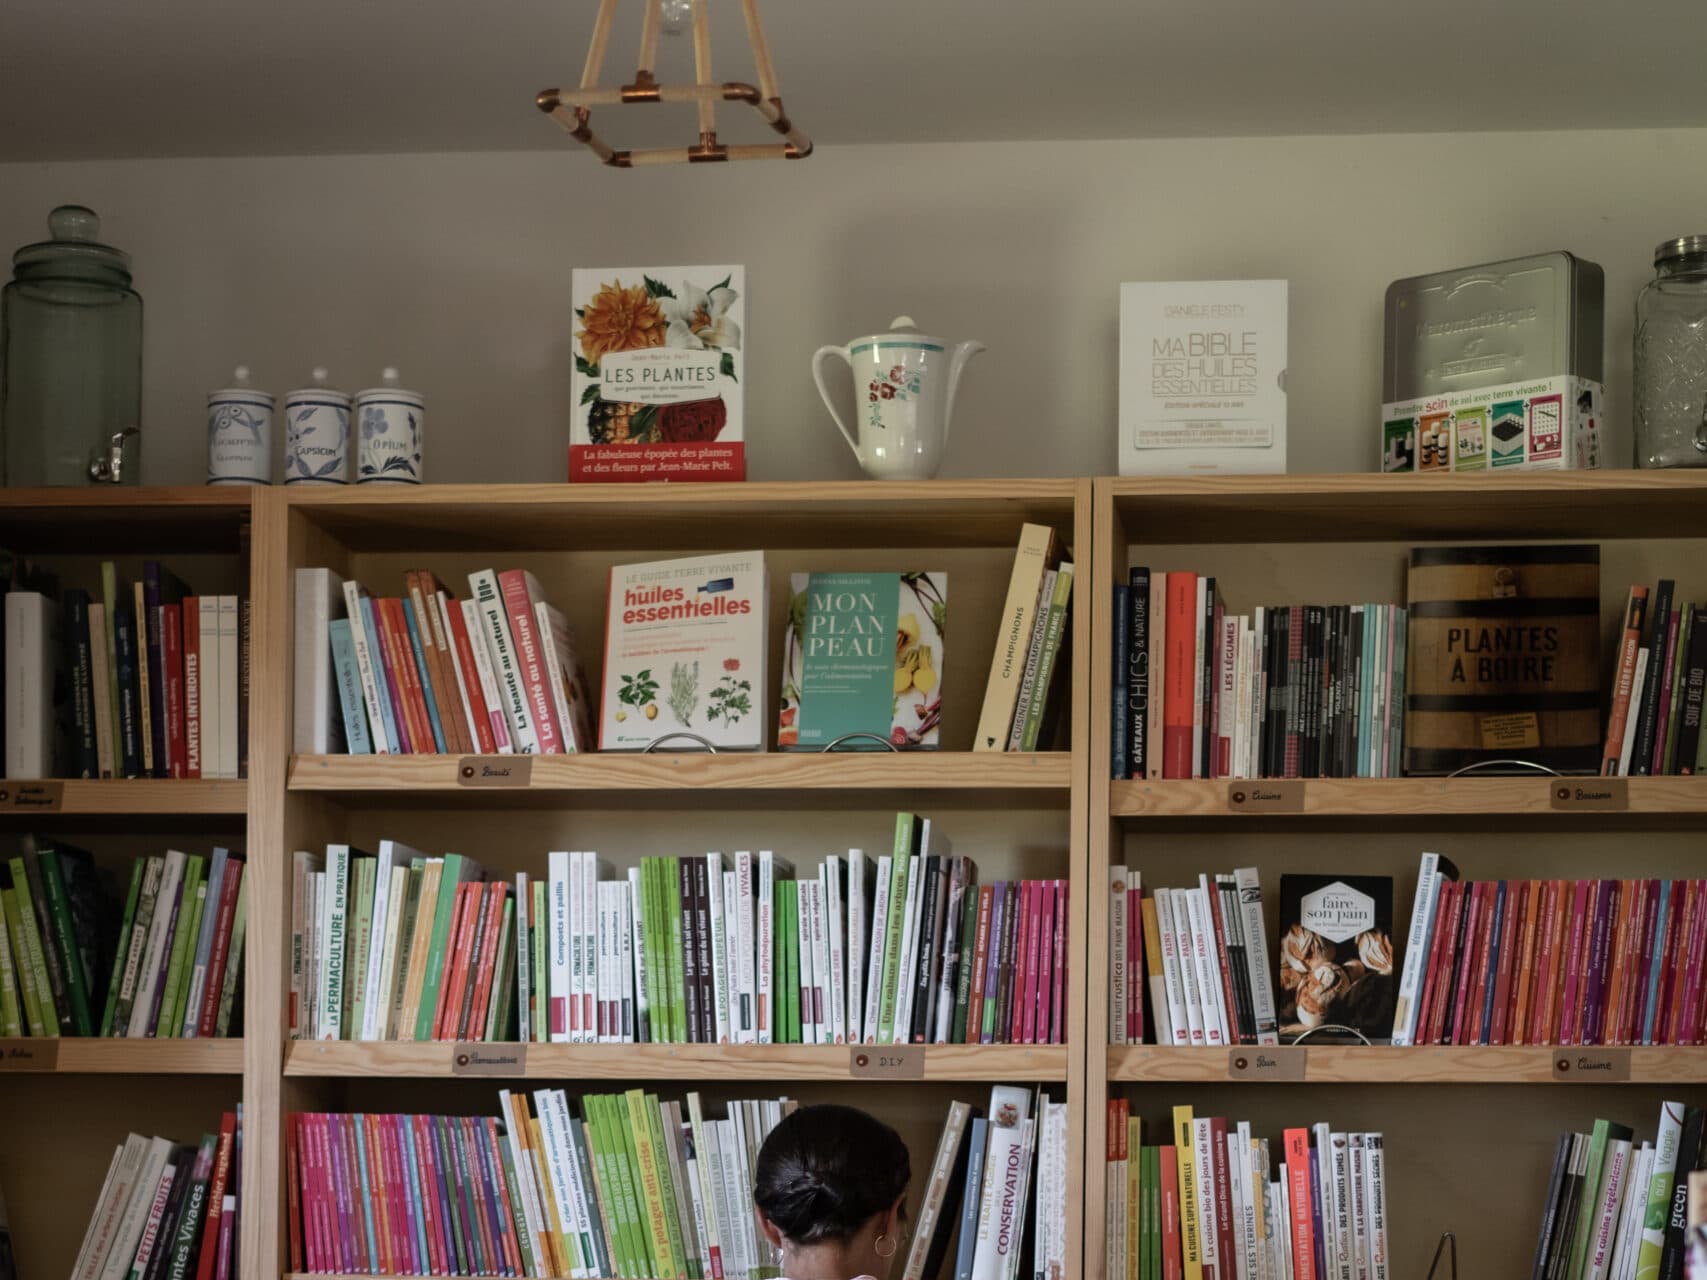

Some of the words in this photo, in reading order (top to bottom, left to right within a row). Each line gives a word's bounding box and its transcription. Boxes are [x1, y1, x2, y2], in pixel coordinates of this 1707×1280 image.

[1152, 338, 1184, 356] MA
[1189, 332, 1257, 356] BIBLE
[605, 369, 634, 383] LES
[643, 367, 715, 382] PLANTES
[1152, 363, 1184, 378] DES
[1187, 358, 1257, 378] HUILES
[1152, 379, 1257, 393] ESSENTIELLES
[1450, 398, 1458, 407] de
[1493, 390, 1514, 400] terre
[1516, 384, 1547, 395] vivante
[583, 451, 595, 459] La
[598, 449, 642, 459] fabuleuse
[645, 448, 678, 461] épopée
[680, 448, 697, 458] des
[699, 449, 732, 460] plantes
[583, 463, 592, 472] et
[594, 462, 609, 472] des
[612, 462, 638, 471] fleurs
[641, 463, 655, 474] par
[658, 462, 709, 471] Jean-Marie
[626, 575, 637, 583] LE
[640, 571, 672, 582] GUIDE
[675, 568, 704, 577] TERRE
[709, 563, 752, 574] VIVANTE
[625, 586, 683, 607] huiles
[814, 593, 876, 612] MON
[623, 597, 751, 623] essentielles
[1135, 597, 1146, 637] NATURE
[487, 610, 507, 656] naturel
[811, 616, 886, 635] PLAN
[1047, 611, 1060, 638] FRANCE
[515, 615, 537, 662] naturel
[808, 638, 884, 656] PEAU
[1002, 606, 1024, 679] CHAMPIGNONS
[1045, 641, 1054, 650] DE
[1136, 640, 1144, 648] &
[1448, 627, 1559, 653] PLANTES
[499, 659, 510, 672] au
[527, 665, 539, 682] au
[1035, 651, 1053, 701] CHAMPIGNONS
[1478, 656, 1555, 683] BOIRE
[1690, 668, 1704, 686] BIO
[185, 653, 198, 718] INTERDITES
[1129, 652, 1148, 710] CHICS
[503, 674, 525, 713] beauté
[530, 684, 550, 720] santé
[1688, 688, 1701, 701] DE
[1032, 702, 1041, 715] LES
[1685, 704, 1698, 726] SOIF
[515, 716, 527, 729] La
[541, 723, 553, 740] La
[187, 720, 199, 770] PLANTES
[1133, 714, 1143, 763] GÂTEAUX
[336, 852, 345, 894] PRATIQUE
[335, 896, 344, 908] EN
[892, 875, 905, 911] arbres
[889, 914, 901, 931] les
[1306, 911, 1332, 919] son
[1337, 911, 1368, 923] pain
[1249, 908, 1262, 953] FARINES
[888, 933, 899, 959] dans
[327, 914, 343, 1013] PERMACULTURE
[1254, 955, 1267, 991] DOUZE
[885, 962, 897, 1000] cabane
[882, 1003, 893, 1024] Une
[1260, 993, 1268, 1012] LES
[330, 1015, 338, 1026] LA
[1198, 1123, 1207, 1141] fête
[214, 1132, 231, 1177] vagabond
[1199, 1143, 1208, 1154] de
[1216, 1143, 1224, 1167] cuisine
[1658, 1128, 1675, 1166] Veggie
[640, 1141, 657, 1197] anti-crise
[1201, 1156, 1213, 1180] jours
[1335, 1153, 1344, 1176] FUMÉS
[1184, 1163, 1194, 1199] NATURELLE
[1202, 1182, 1211, 1196] des
[1219, 1185, 1227, 1200] Dico
[1603, 1152, 1625, 1213] végétarienne
[209, 1180, 224, 1218] Herbier
[997, 1144, 1021, 1255] CONSERVATION
[1203, 1198, 1212, 1212] bio
[1295, 1170, 1307, 1219] NATURELLE
[1336, 1178, 1347, 1213] PRODUITS
[1671, 1184, 1688, 1229] green
[137, 1222, 160, 1263] PETITS
[151, 1176, 172, 1219] FRUITS
[180, 1183, 204, 1240] Vivaces
[651, 1199, 669, 1245] potager
[1185, 1201, 1195, 1221] SUPER
[1220, 1201, 1228, 1221] Grand
[1338, 1214, 1347, 1228] DES
[1187, 1223, 1197, 1250] CUISINE
[1204, 1214, 1213, 1245] cuisine
[1221, 1222, 1229, 1230] Le
[1245, 1205, 1256, 1249] TERRINES
[1598, 1216, 1612, 1249] cuisine
[659, 1247, 668, 1259] Le
[1189, 1251, 1197, 1262] MA
[1205, 1247, 1214, 1257] La
[1339, 1231, 1351, 1262] Rustica
[1593, 1251, 1605, 1266] Ma
[1248, 1251, 1258, 1268] SES
